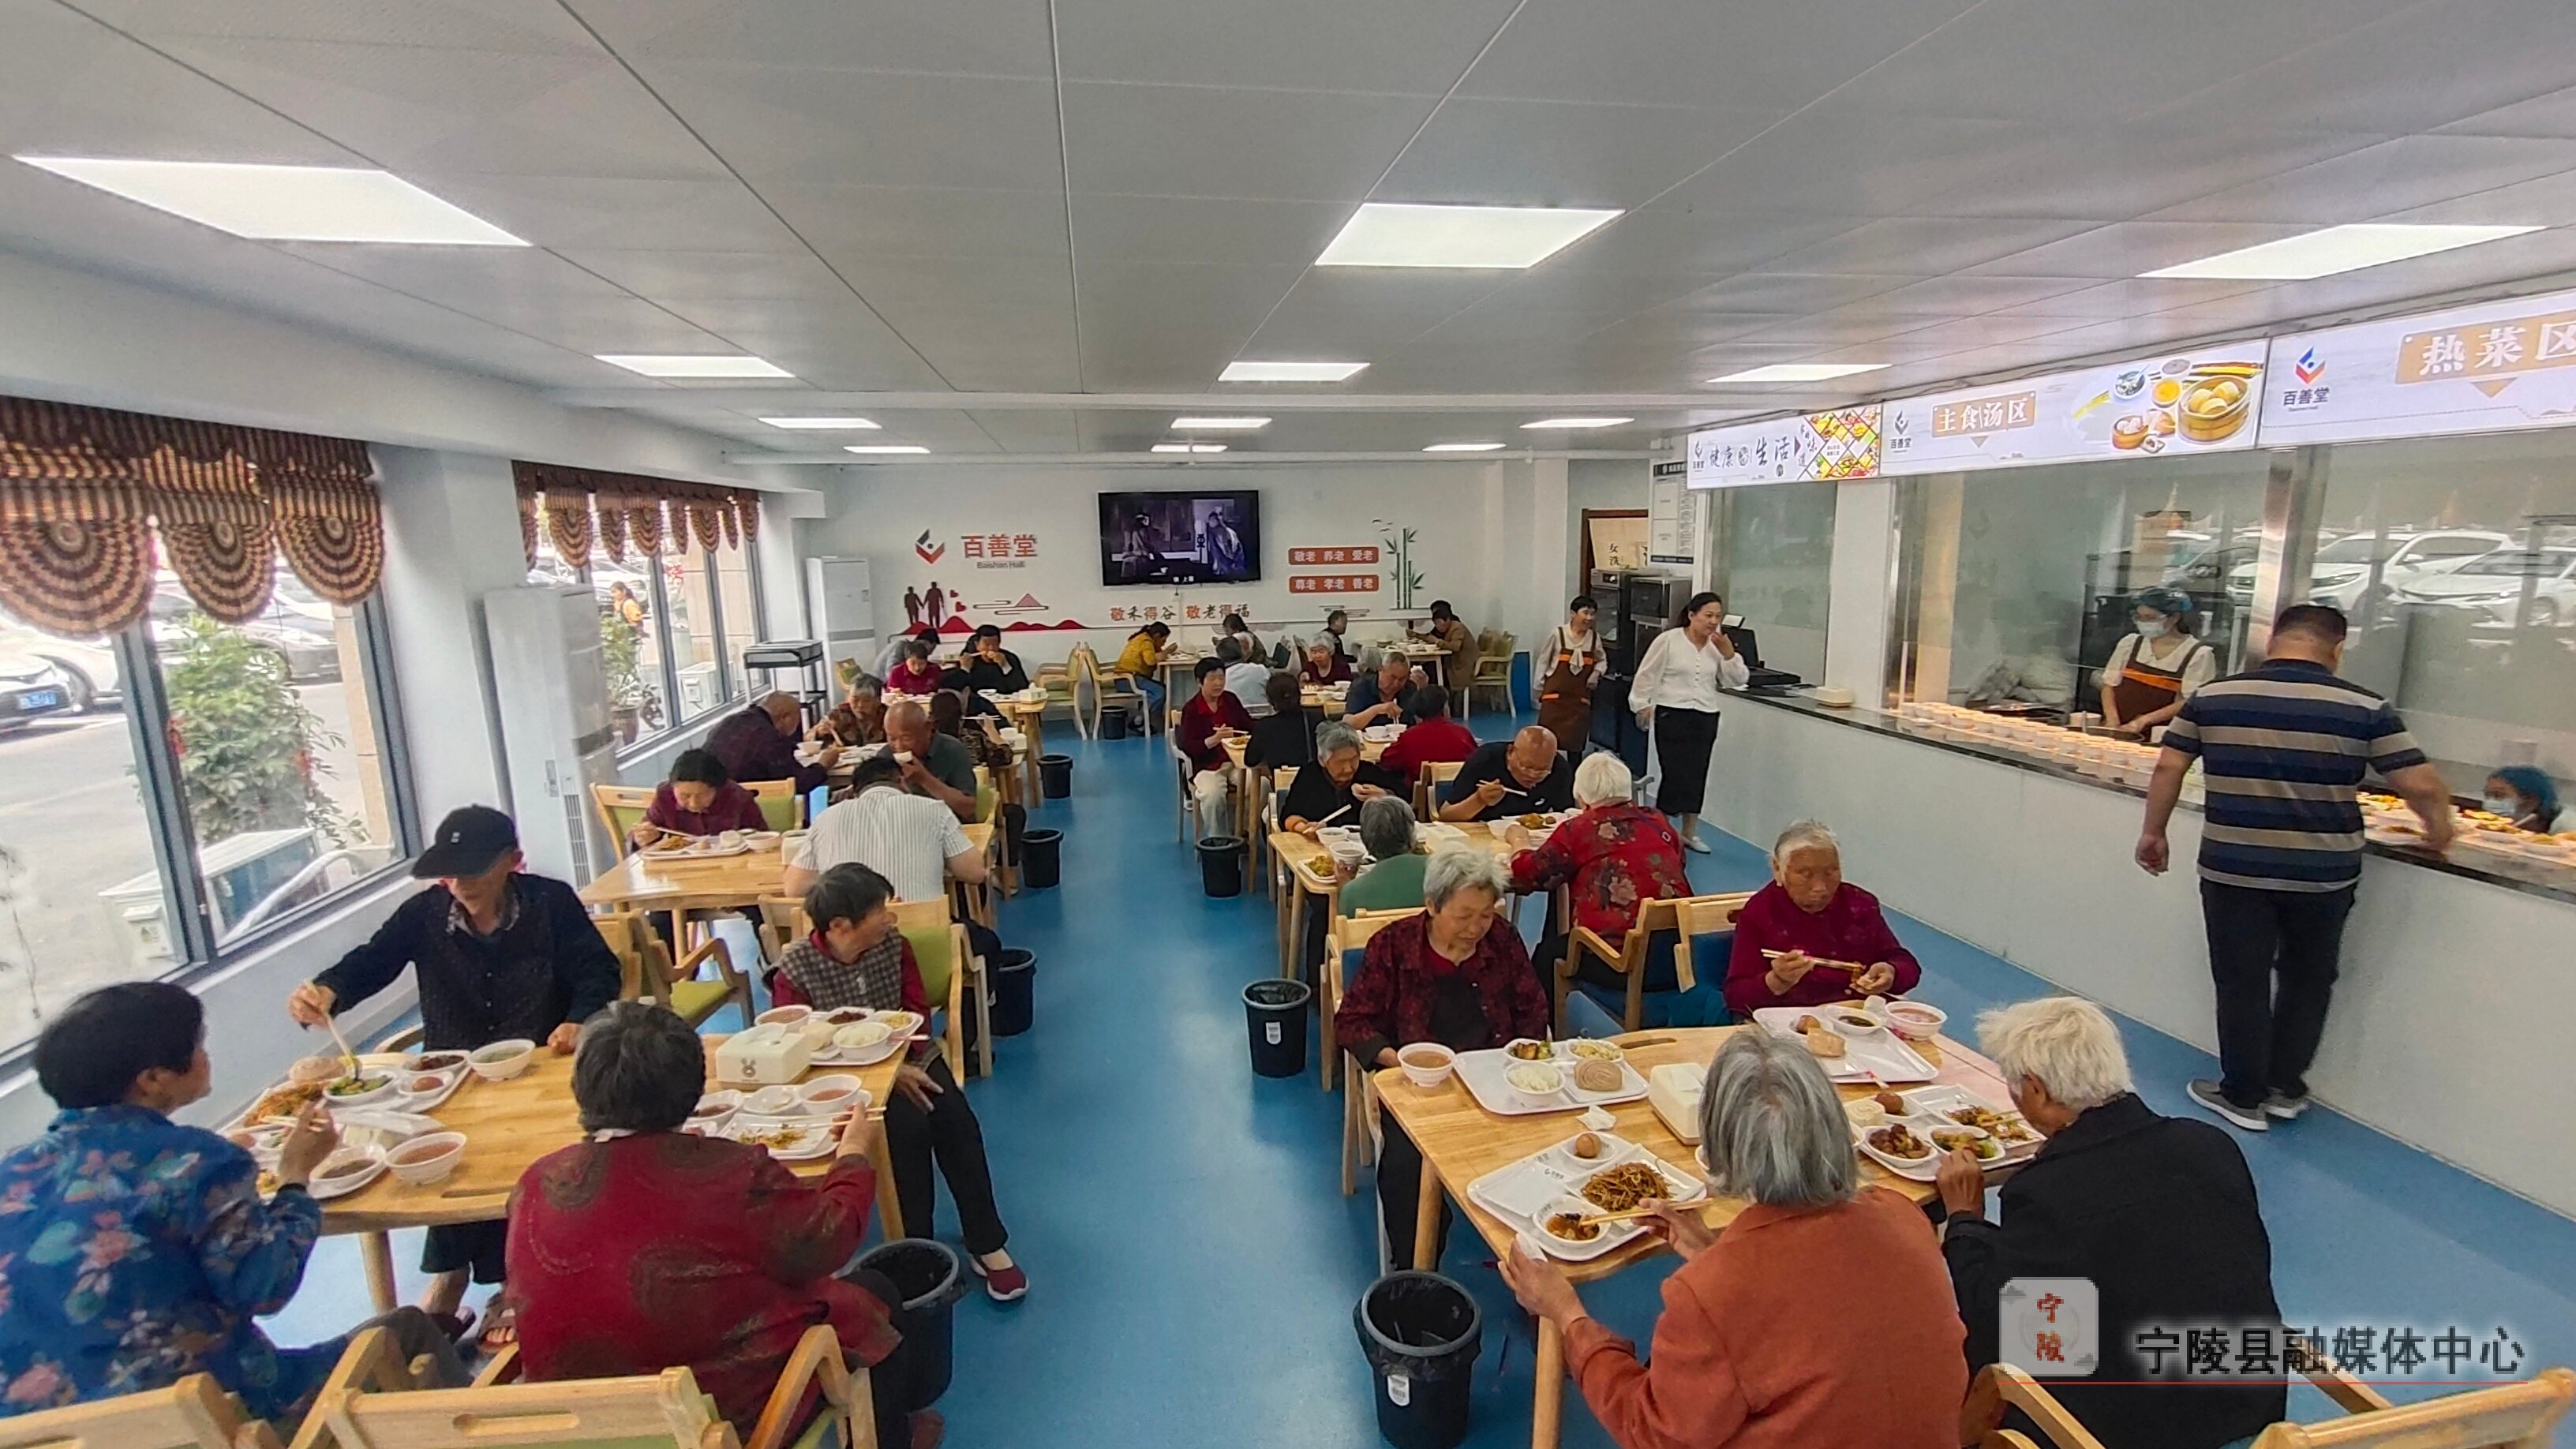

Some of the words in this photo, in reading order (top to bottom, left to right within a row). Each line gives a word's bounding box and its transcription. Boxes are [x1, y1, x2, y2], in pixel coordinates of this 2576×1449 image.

[2419, 320, 2576, 376] 热菜区
[2283, 387, 2330, 406] 百善堂
[960, 534, 1038, 558] 百善堂
[1110, 605, 1177, 622] 敬禾得谷
[1185, 604, 1251, 620] 敬老得福
